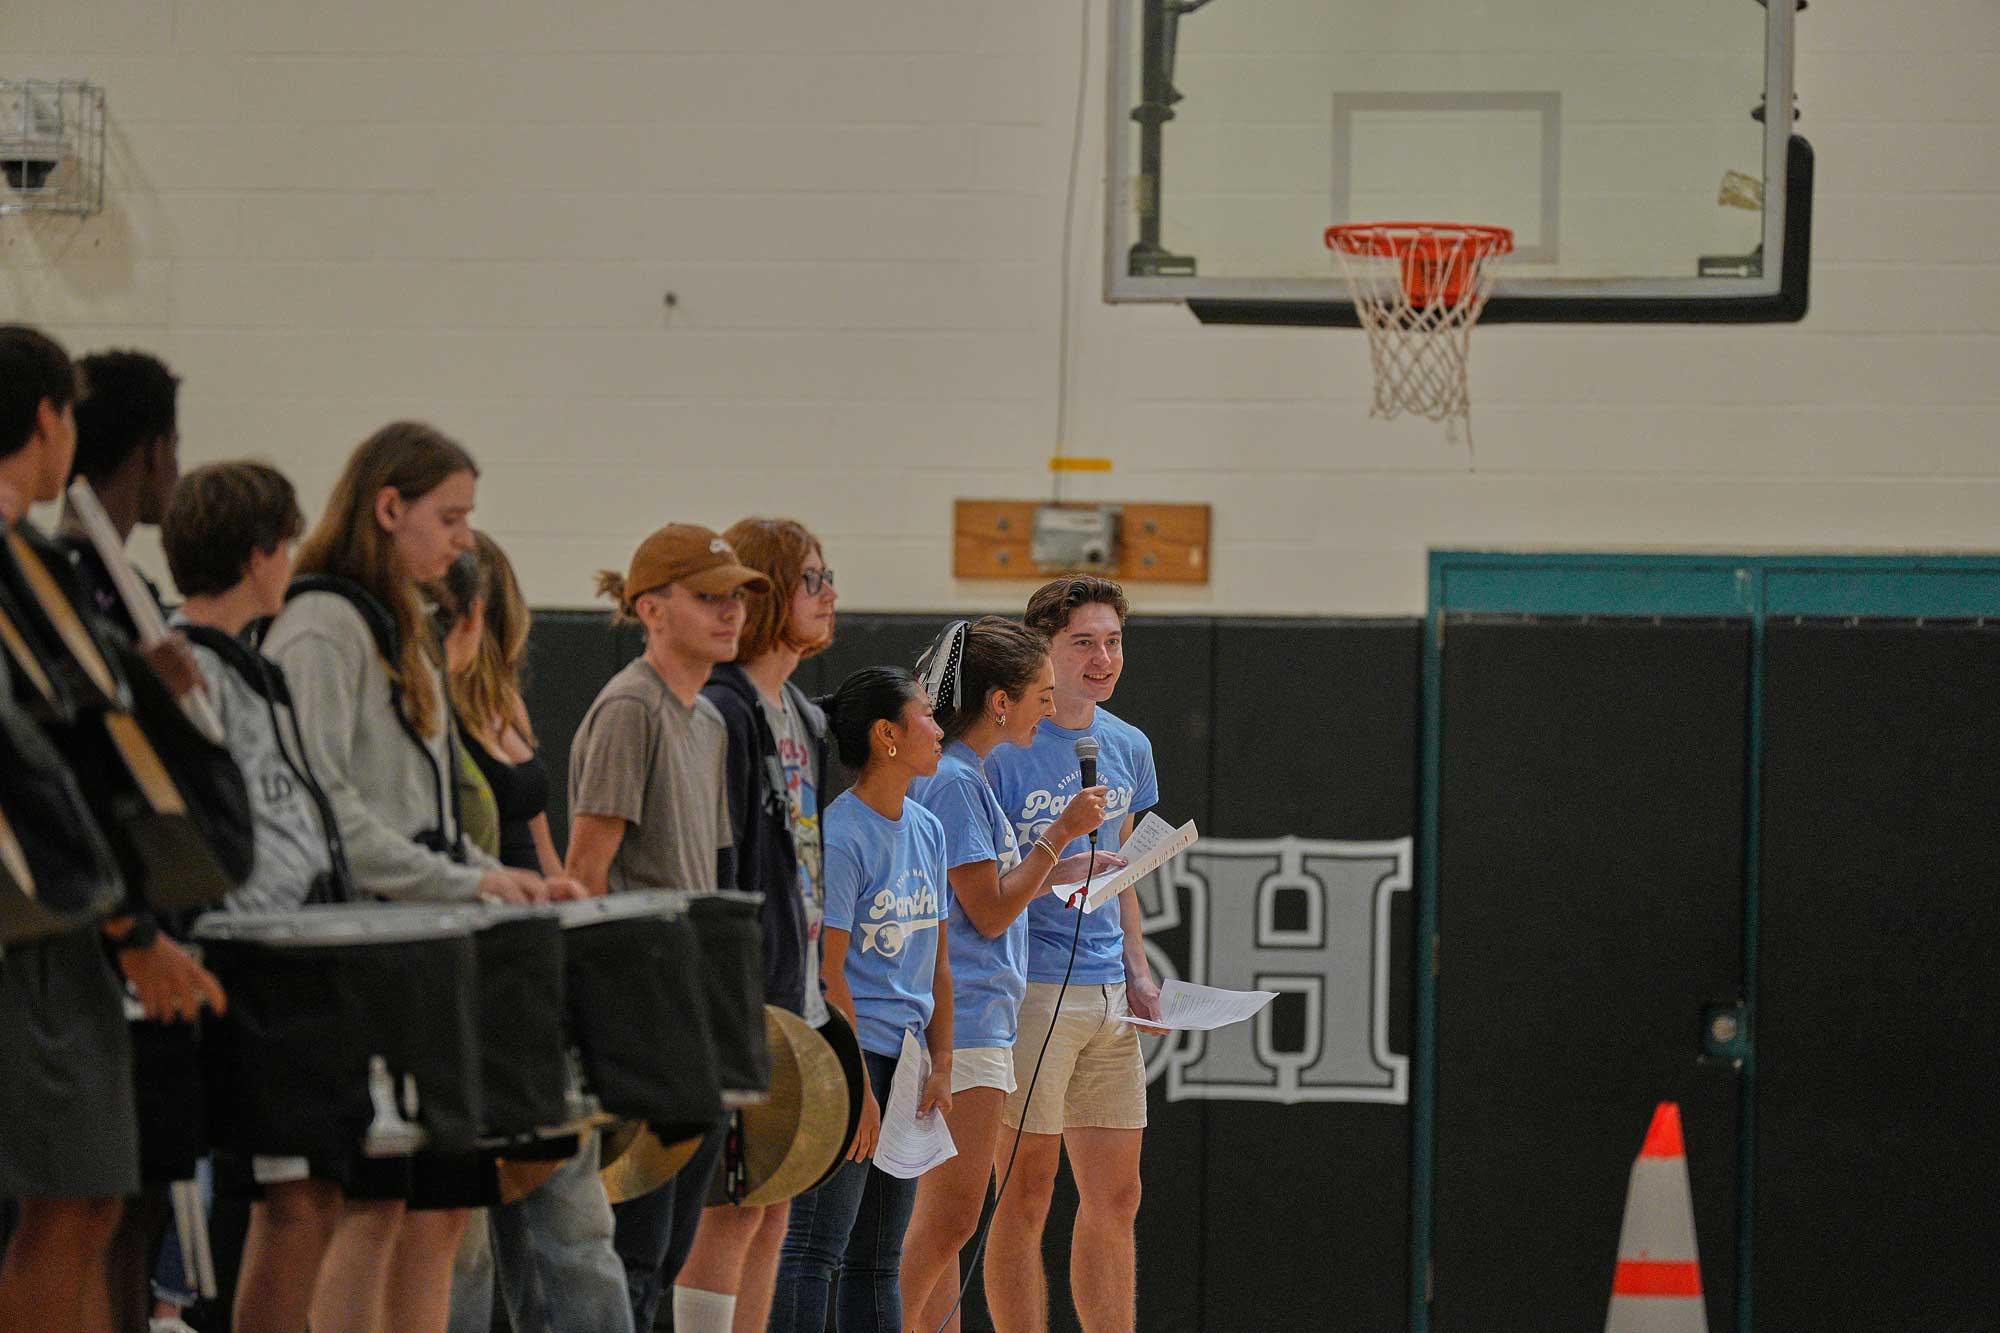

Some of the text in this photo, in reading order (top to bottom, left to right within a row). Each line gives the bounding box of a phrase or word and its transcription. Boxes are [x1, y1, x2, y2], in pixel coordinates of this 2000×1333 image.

[1057, 769, 1109, 790] STRAT VEN
[1021, 785, 1133, 819] Paer
[1140, 836, 1413, 1105] H
